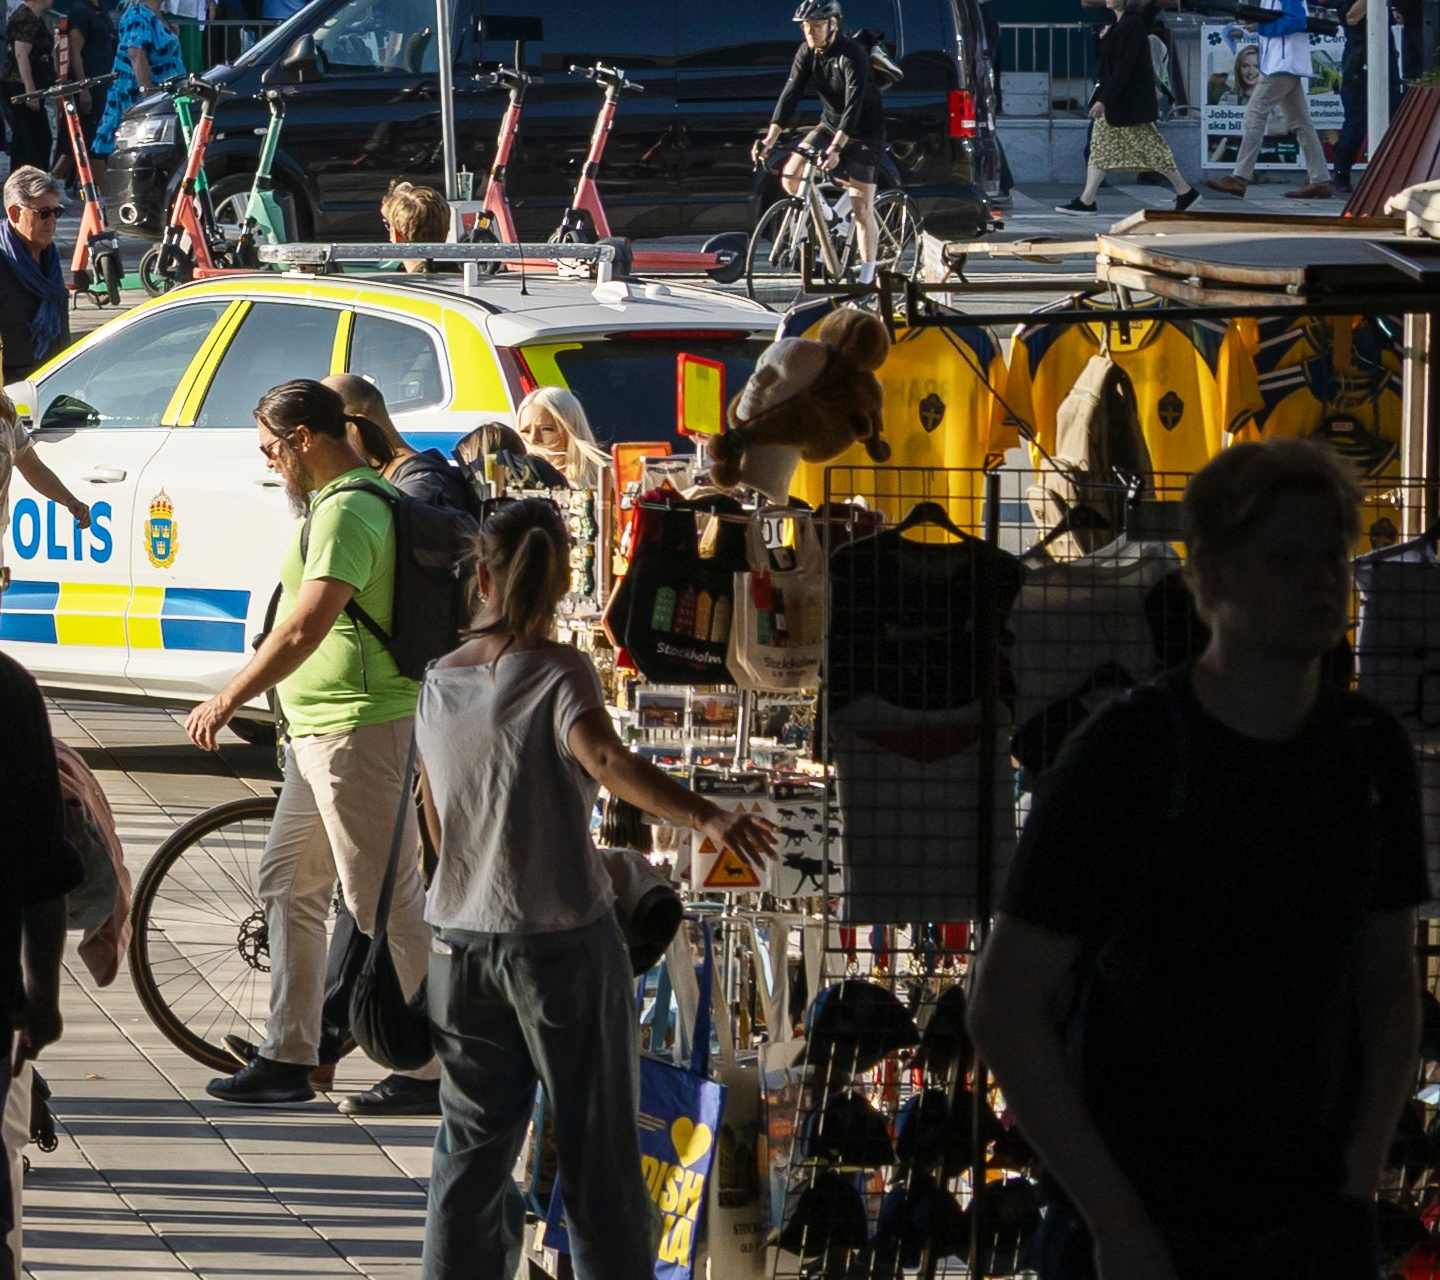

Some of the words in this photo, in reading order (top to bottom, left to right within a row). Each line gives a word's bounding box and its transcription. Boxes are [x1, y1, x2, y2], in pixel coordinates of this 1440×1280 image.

[1310, 98, 1341, 109] Stoppa
[1207, 121, 1226, 131] ska
[1228, 120, 1242, 131] bli
[12, 498, 113, 564] OLIS
[656, 641, 722, 665] Stockholm
[640, 1153, 705, 1221] DISH
